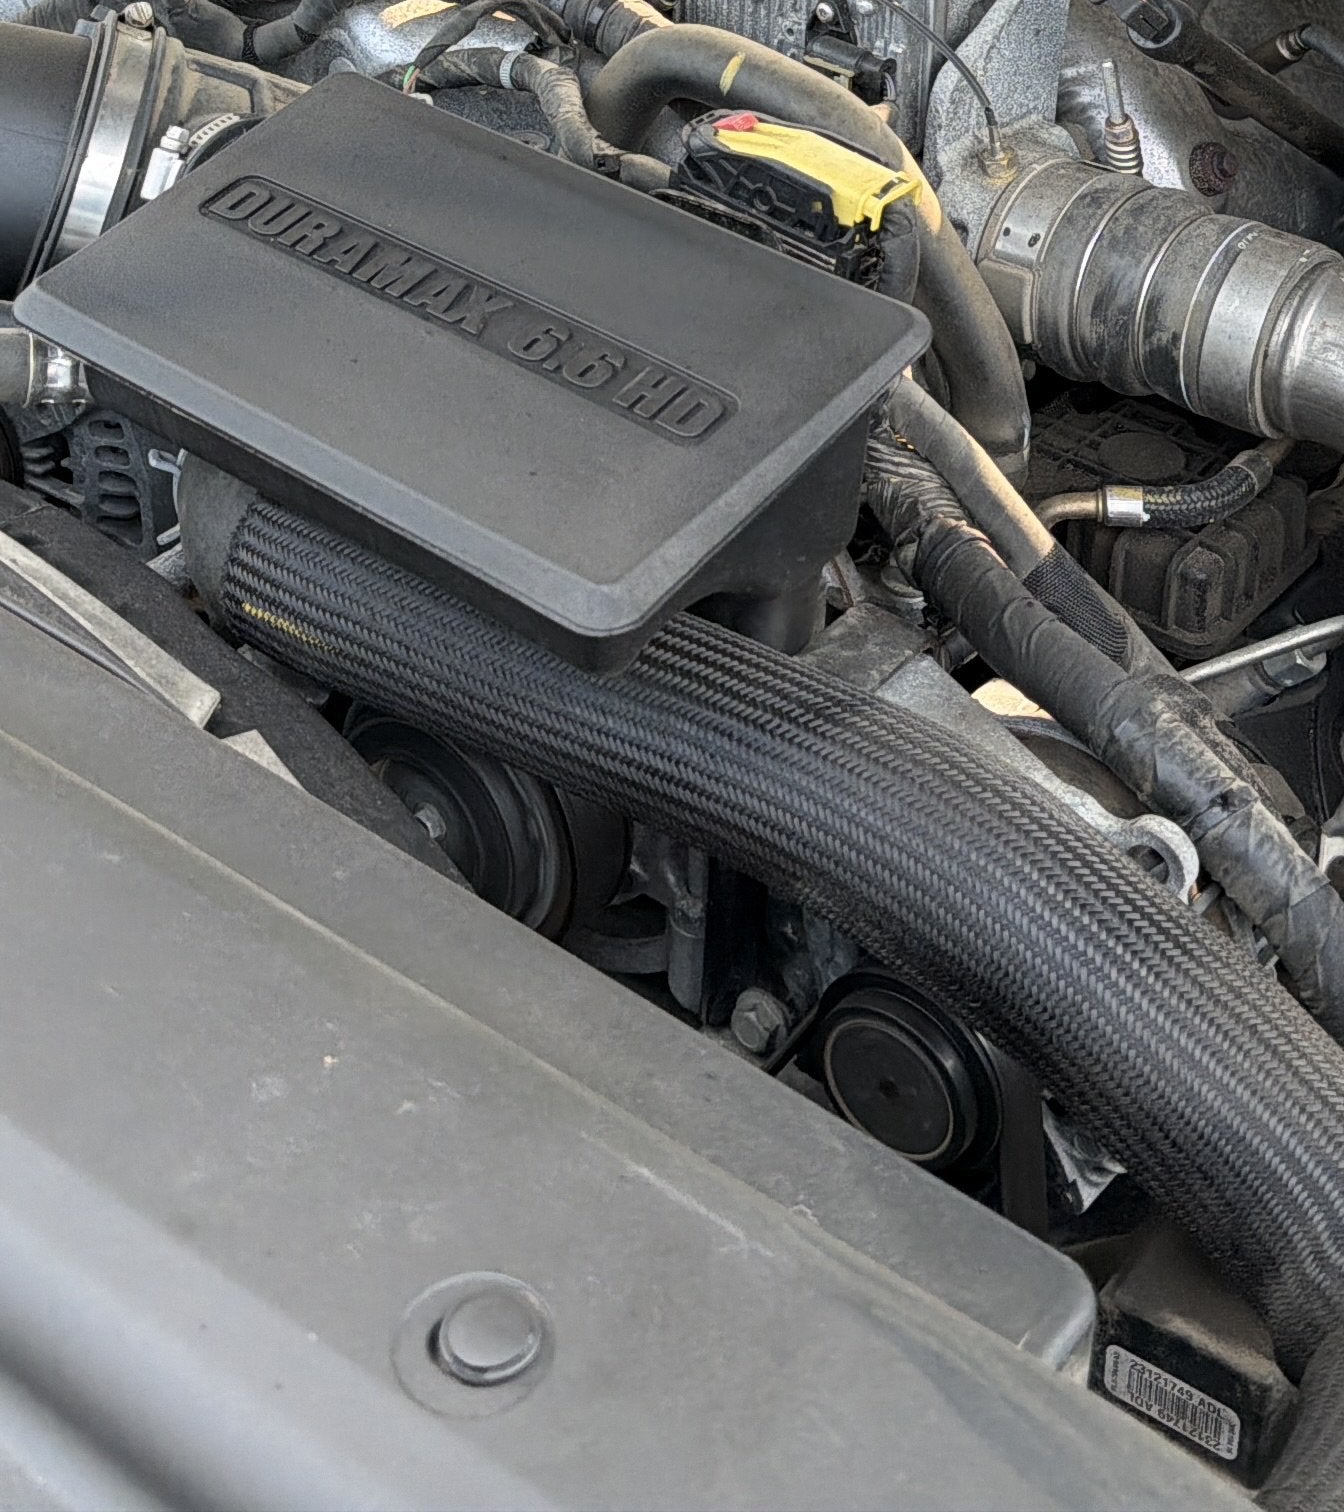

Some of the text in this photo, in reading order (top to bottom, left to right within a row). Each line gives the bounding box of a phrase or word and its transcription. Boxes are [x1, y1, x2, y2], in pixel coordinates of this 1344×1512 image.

[207, 186, 726, 439] DURAMAX 6.6 HD
[1130, 1360, 1193, 1401] 23121749
